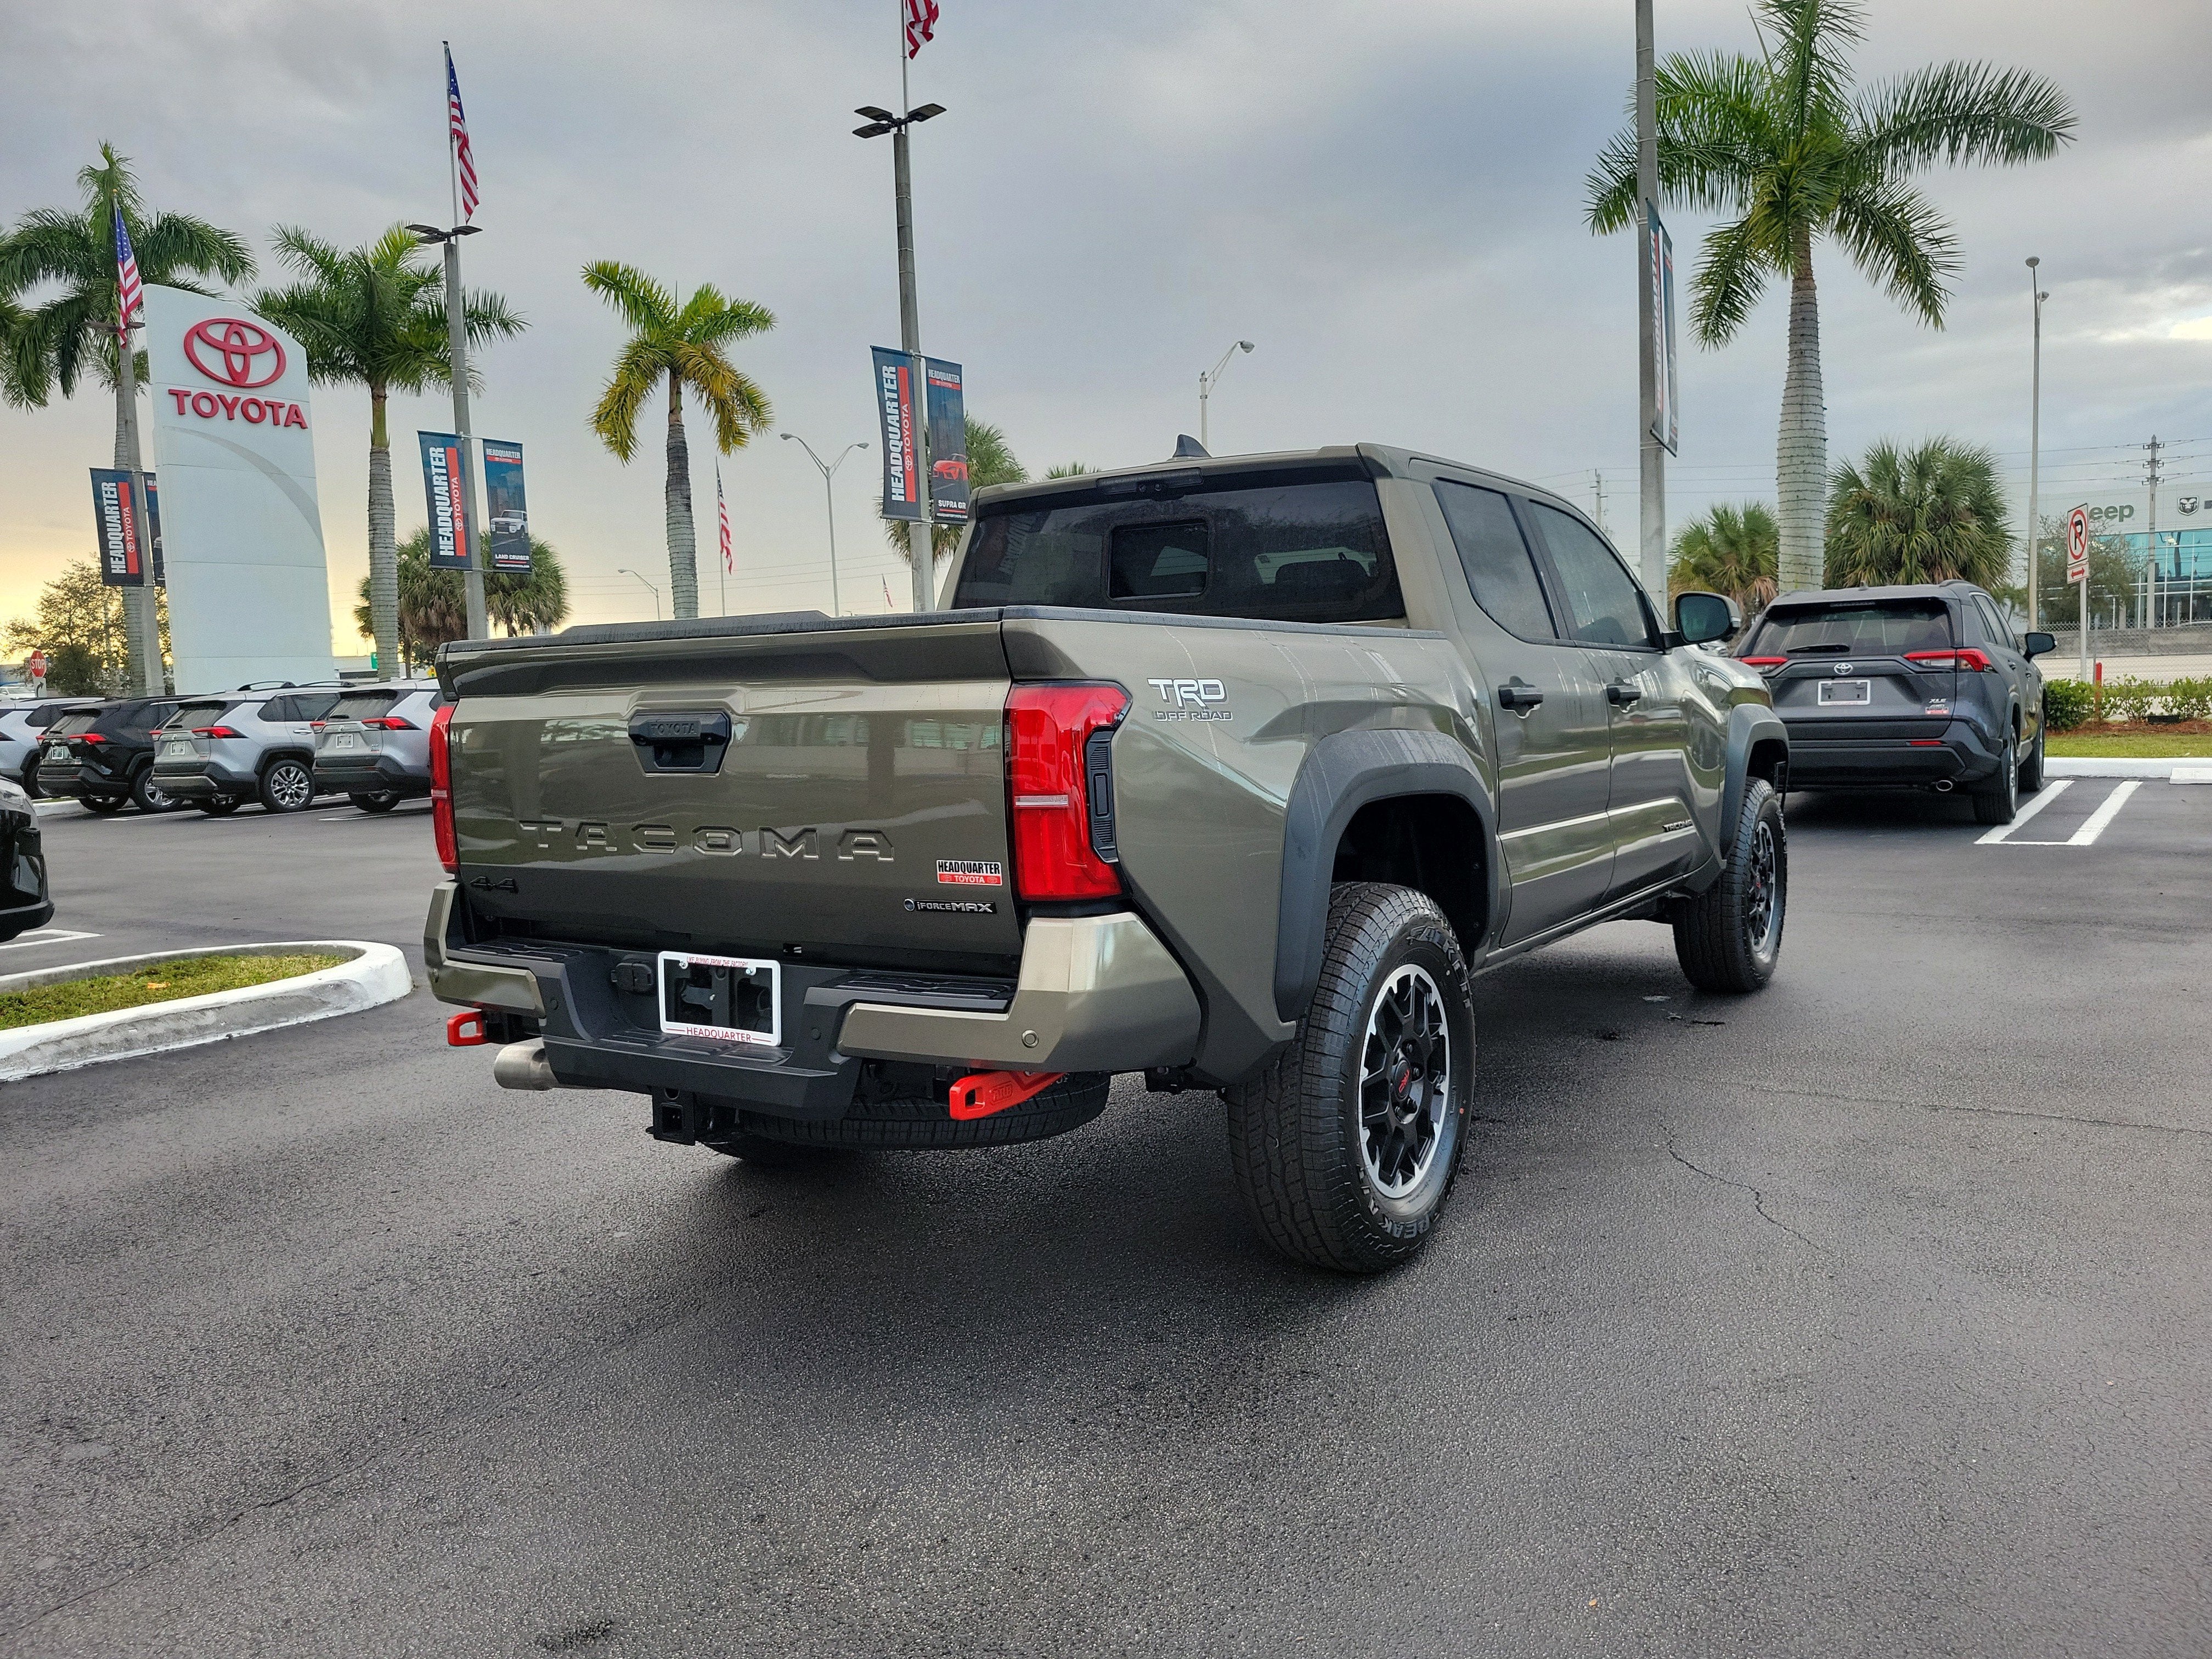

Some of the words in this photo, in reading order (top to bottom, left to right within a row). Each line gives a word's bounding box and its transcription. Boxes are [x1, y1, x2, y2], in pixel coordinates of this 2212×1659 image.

[928, 369, 960, 384] HEADQUARTER
[168, 389, 308, 430] TOYOTA
[882, 365, 905, 502] HEADQUARTER
[902, 404, 912, 455] TOYOTA
[486, 448, 521, 459] HEADQUARTER
[429, 447, 455, 556] HEADQUARTER
[450, 476, 462, 517] TOYOTA
[938, 500, 957, 509] SUPRA
[2089, 504, 2135, 522] eep
[101, 482, 127, 574] HEADQUARTER
[123, 507, 134, 541] TOYOTA
[31, 659, 45, 669] STOP
[1147, 678, 1227, 710] TRD
[1153, 711, 1187, 721] OFF
[1189, 711, 1233, 721] ROAD
[651, 723, 697, 736] TOYOTA
[519, 820, 895, 862] TACOMA
[938, 861, 1001, 874] HEADQUARTER
[954, 875, 985, 884] TOYOTA
[686, 1027, 752, 1042] HEADQUARTER
